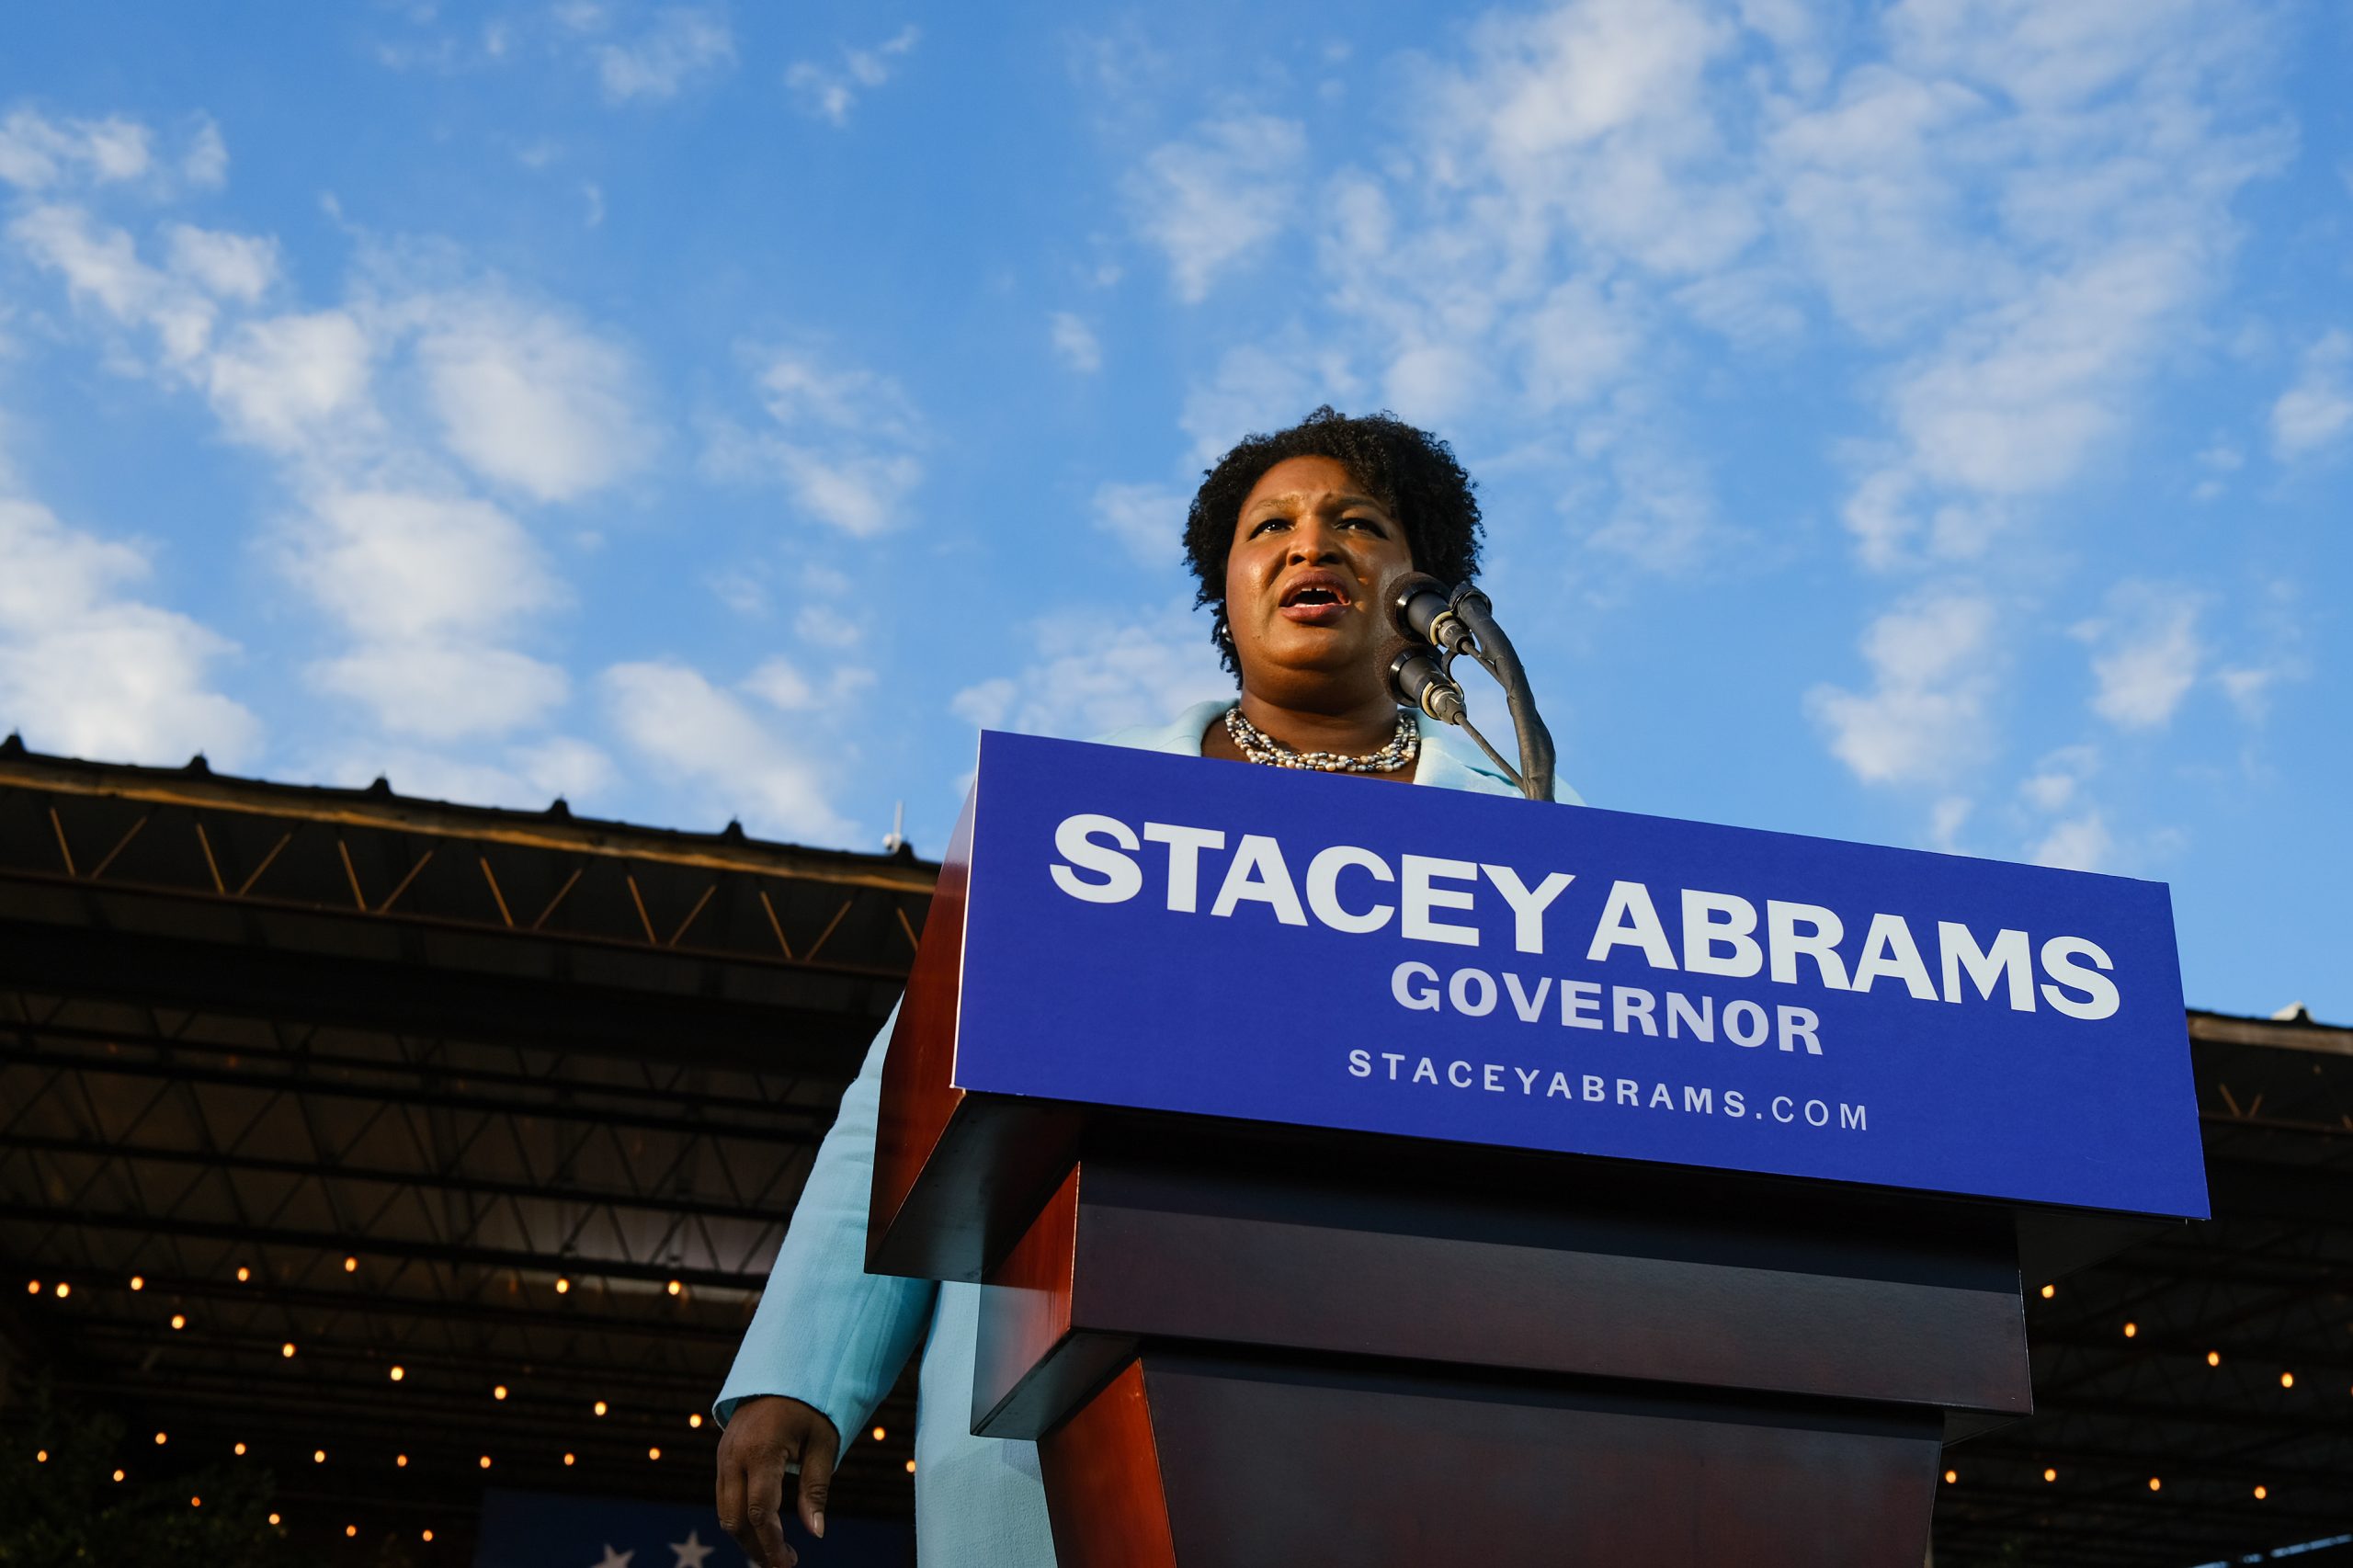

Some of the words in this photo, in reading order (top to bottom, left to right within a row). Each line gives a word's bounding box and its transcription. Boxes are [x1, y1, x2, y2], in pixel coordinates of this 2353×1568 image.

[1049, 813, 1576, 955] STACEY
[1586, 880, 2120, 1020] ABRAMS
[1391, 960, 1824, 1055] GOVERNOR
[1347, 1049, 1868, 1131] STACEYABRAMS.COM
